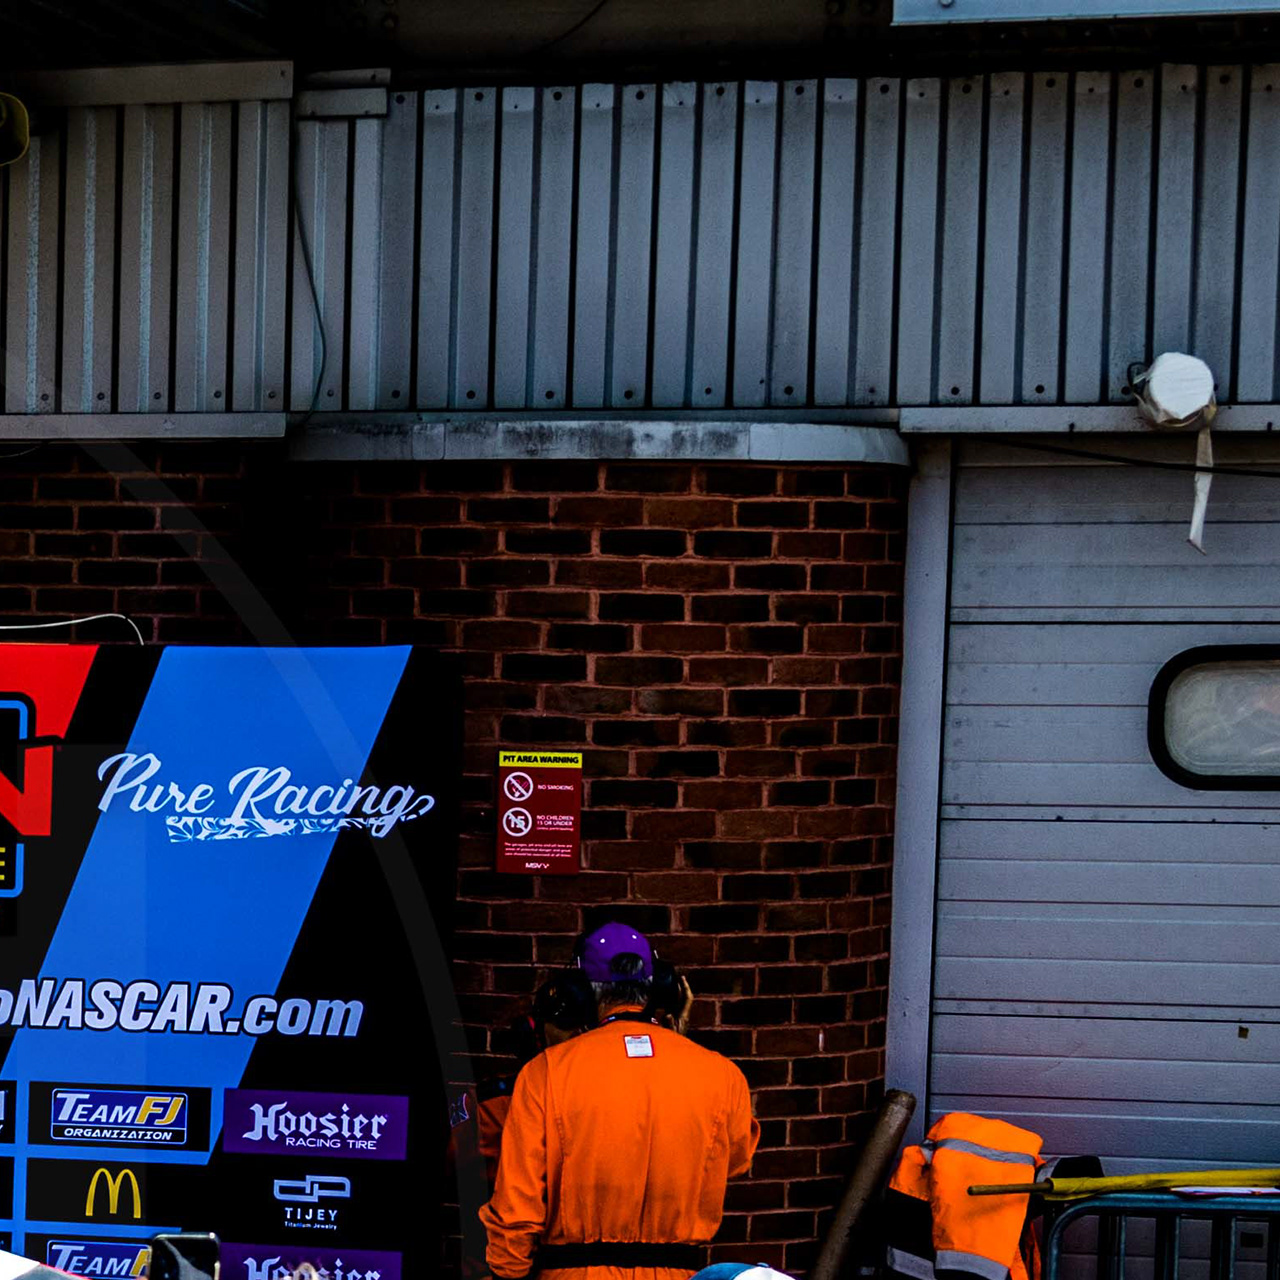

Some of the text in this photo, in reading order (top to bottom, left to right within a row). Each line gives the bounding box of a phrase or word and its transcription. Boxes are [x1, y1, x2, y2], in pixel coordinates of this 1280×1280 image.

[503, 755, 579, 764] PIT AREA WARNING
[97, 753, 435, 838] Pure Racing
[242, 1100, 388, 1142] Hoosier
[64, 1128, 173, 1142] ORGANIZATION
[286, 1138, 378, 1151] RACING TIRE
[284, 1207, 338, 1222] TIJEY
[50, 1244, 151, 1277] TEAMF
